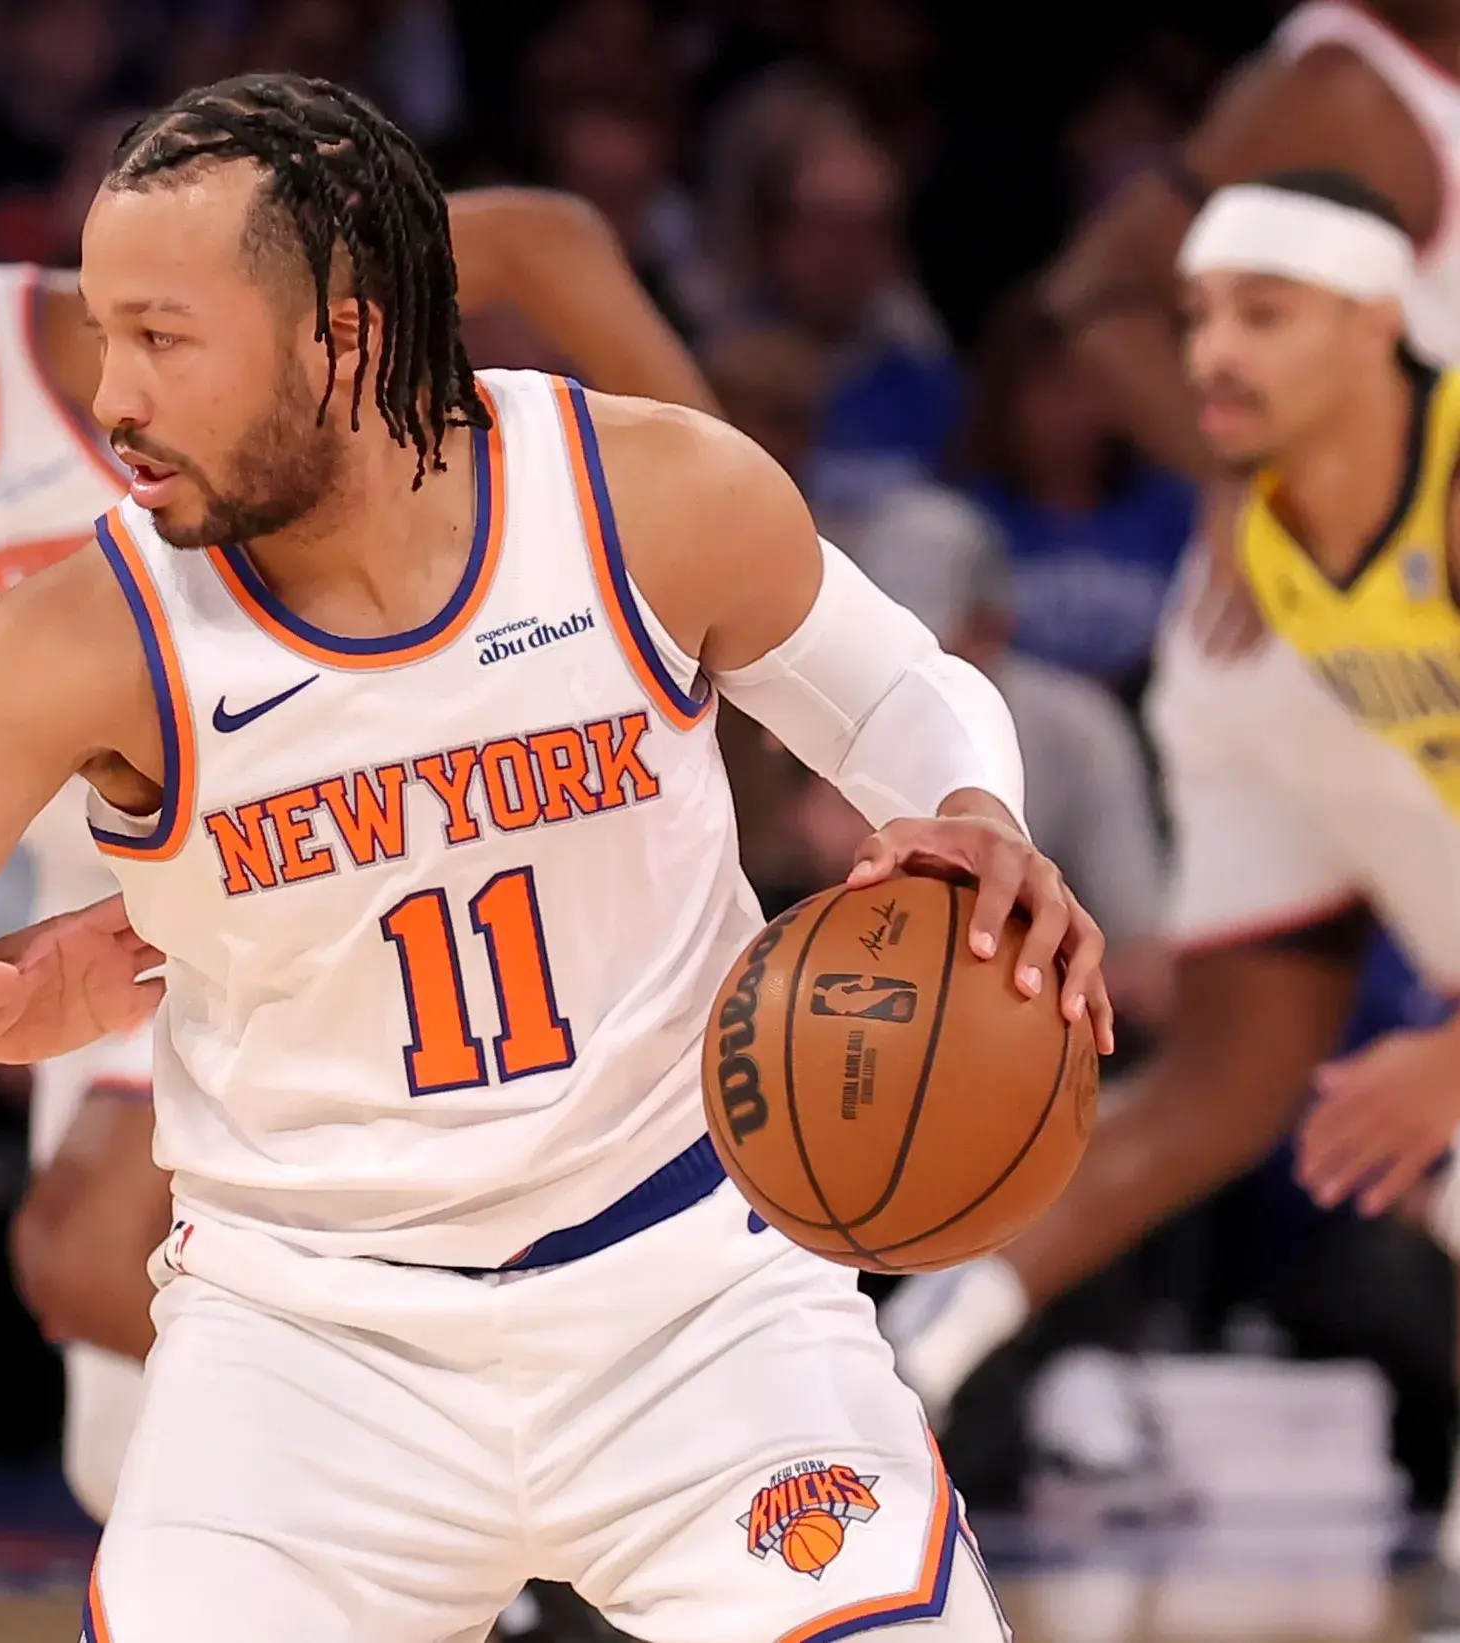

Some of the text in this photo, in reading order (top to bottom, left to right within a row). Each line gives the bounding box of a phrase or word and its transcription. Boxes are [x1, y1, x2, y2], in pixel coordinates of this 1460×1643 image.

[475, 616, 539, 643] experience
[479, 637, 526, 665] abu
[202, 710, 661, 897] NEW YORK
[379, 865, 576, 1097] 11
[794, 1460, 827, 1474] YORK
[747, 1464, 880, 1557] KNICKS
